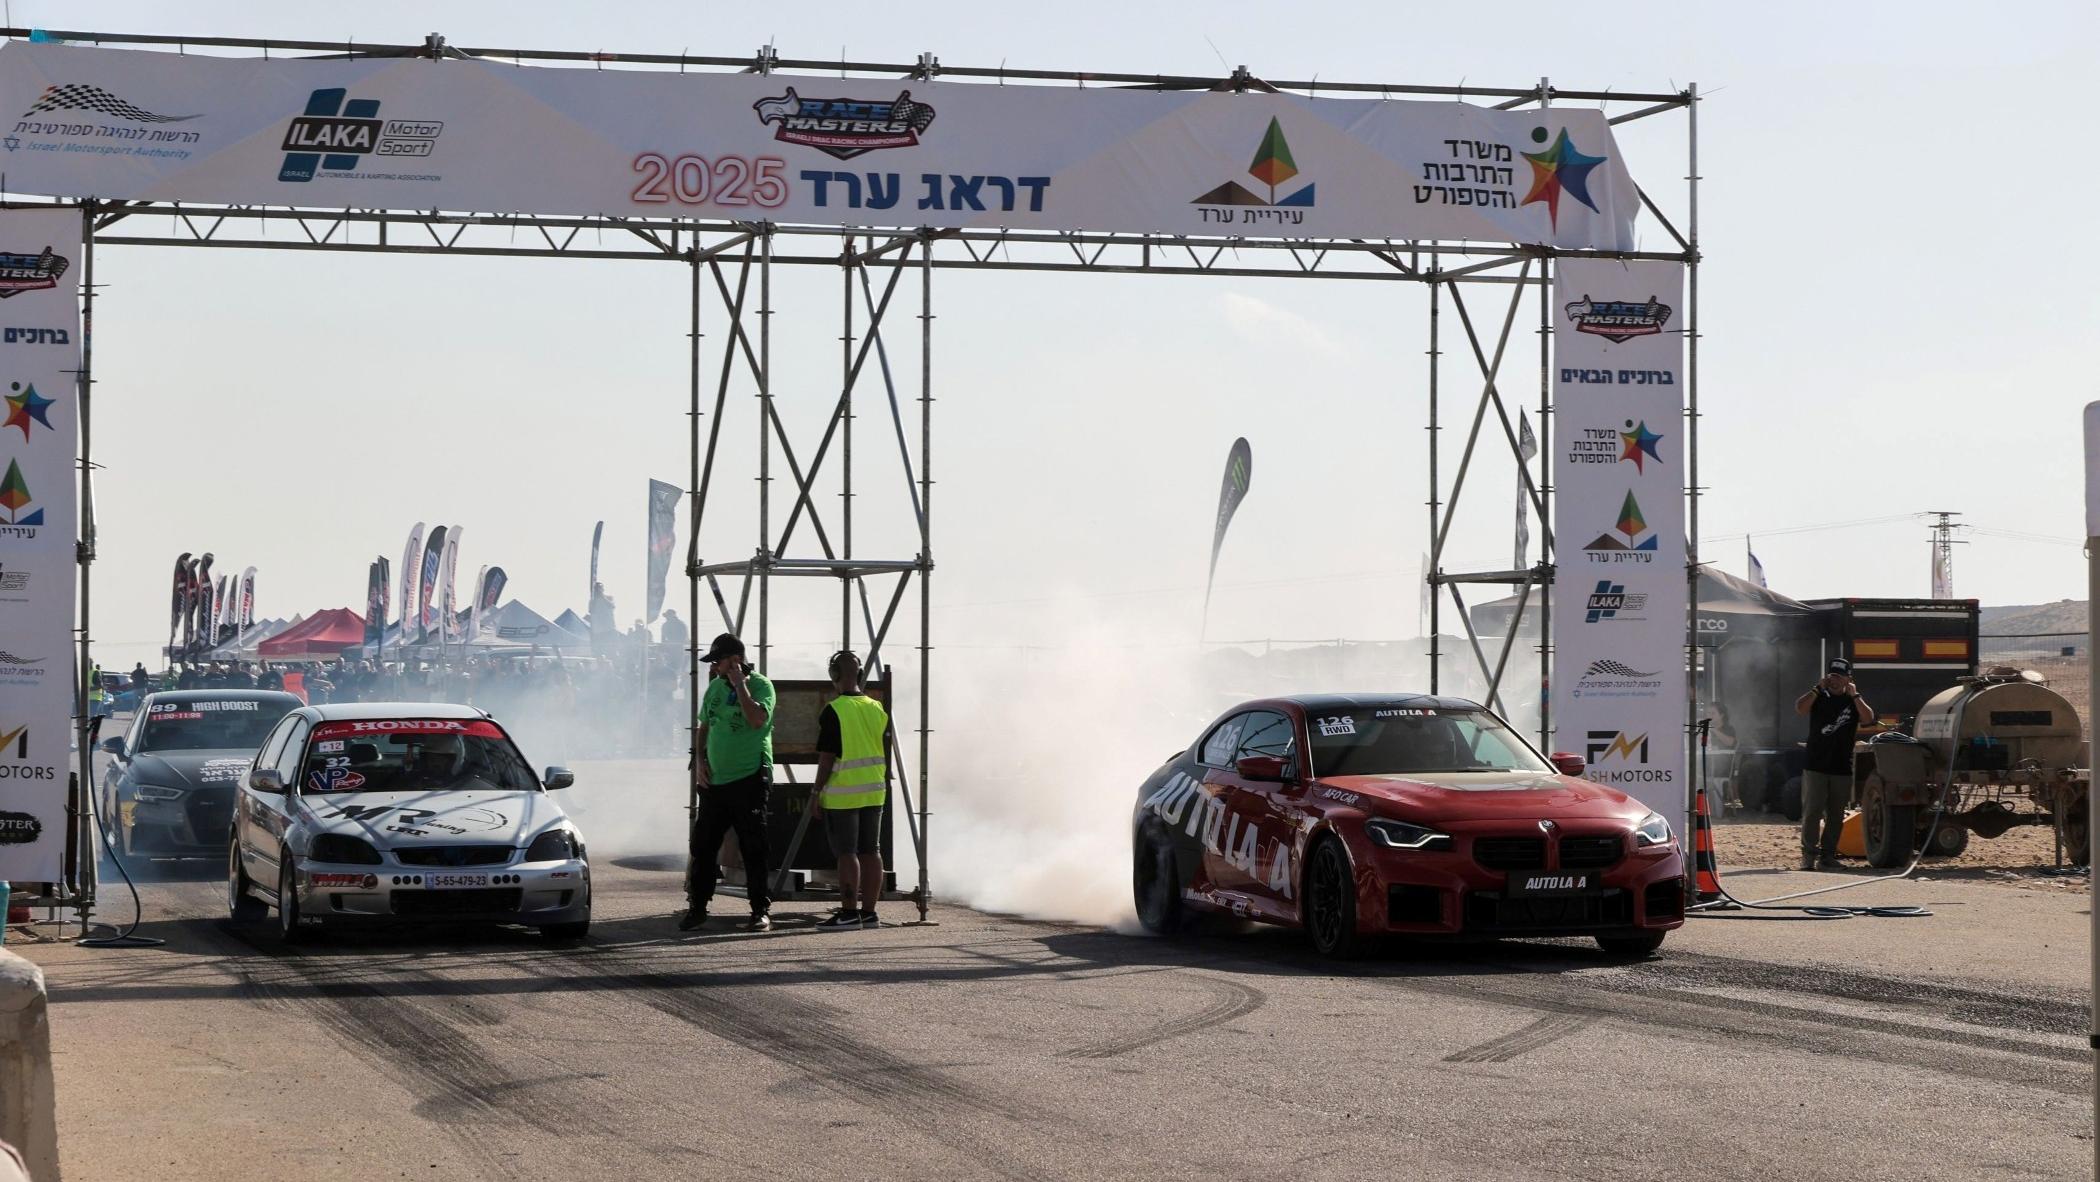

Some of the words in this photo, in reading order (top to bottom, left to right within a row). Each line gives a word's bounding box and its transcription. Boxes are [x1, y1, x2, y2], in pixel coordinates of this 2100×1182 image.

[800, 102, 892, 120] RACE
[13, 120, 94, 137] ספורטיבית
[95, 124, 144, 140] לנהיגה
[388, 123, 438, 136] Motor
[786, 117, 909, 133] MASTERS
[149, 129, 200, 143] הרשות
[288, 123, 370, 148] ILAKA
[28, 141, 62, 151] Israel
[64, 142, 133, 156] Motorsport
[134, 146, 192, 160] Authority
[382, 140, 429, 155] Sport
[1443, 138, 1513, 162] משרד
[634, 154, 788, 207] 2025
[1422, 161, 1514, 186] התרבות
[800, 169, 900, 208] ערד
[917, 173, 1051, 212] דראג
[1413, 184, 1517, 209] והספורט
[1197, 207, 1234, 224] ערד
[1242, 208, 1304, 225] עיריית
[0, 269, 49, 278] TERS
[4, 328, 69, 344] ברוכים
[1560, 368, 1613, 383] הבאים
[1618, 370, 1674, 384] ברוכים
[1583, 429, 1616, 439] משרד
[1573, 441, 1616, 451] התרבות
[1568, 453, 1617, 463] והספורט
[0, 527, 36, 539] עיריי
[1587, 552, 1609, 562] ערד
[1614, 553, 1652, 563] עיריית
[1590, 596, 1620, 607] ILAKA
[192, 701, 221, 712] HIGH
[221, 701, 259, 711] BOOST
[351, 721, 468, 731] HONDA
[1318, 715, 1355, 726] 126
[1325, 725, 1351, 734] RWD
[325, 757, 352, 768] 32
[0, 765, 54, 780] OTORS
[1612, 770, 1673, 783] MOTORS
[1340, 792, 1359, 804] CAR
